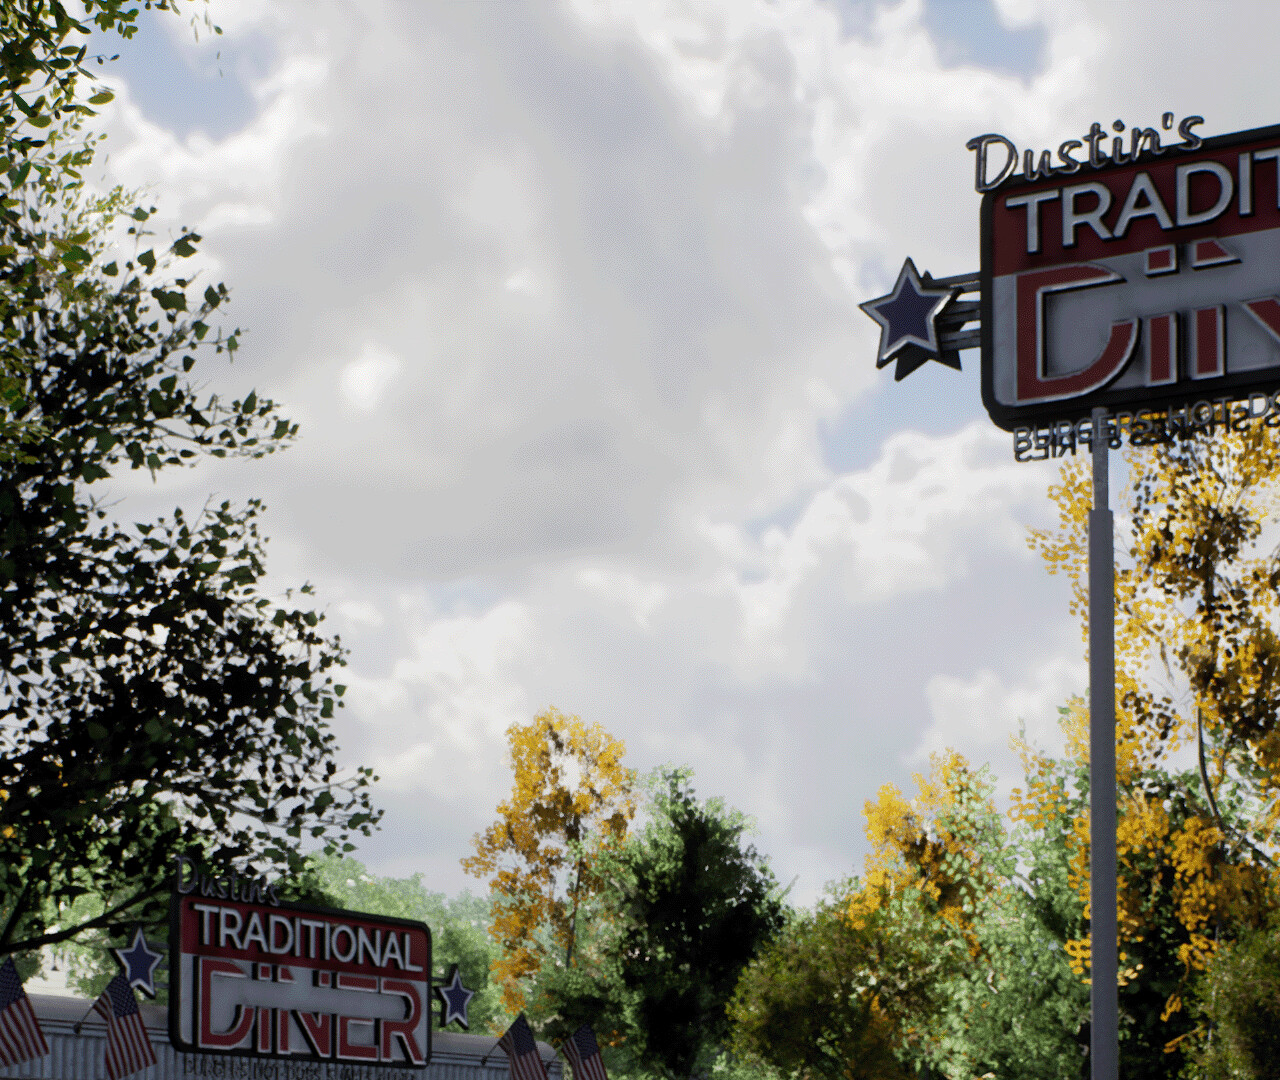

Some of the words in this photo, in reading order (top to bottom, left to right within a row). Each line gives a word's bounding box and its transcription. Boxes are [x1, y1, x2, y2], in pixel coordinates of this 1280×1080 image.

[966, 111, 1205, 194] Dustin's
[193, 903, 424, 973] TRADITIONAL
[198, 955, 425, 1066] DINER
[184, 1056, 251, 1080] BURGRS,
